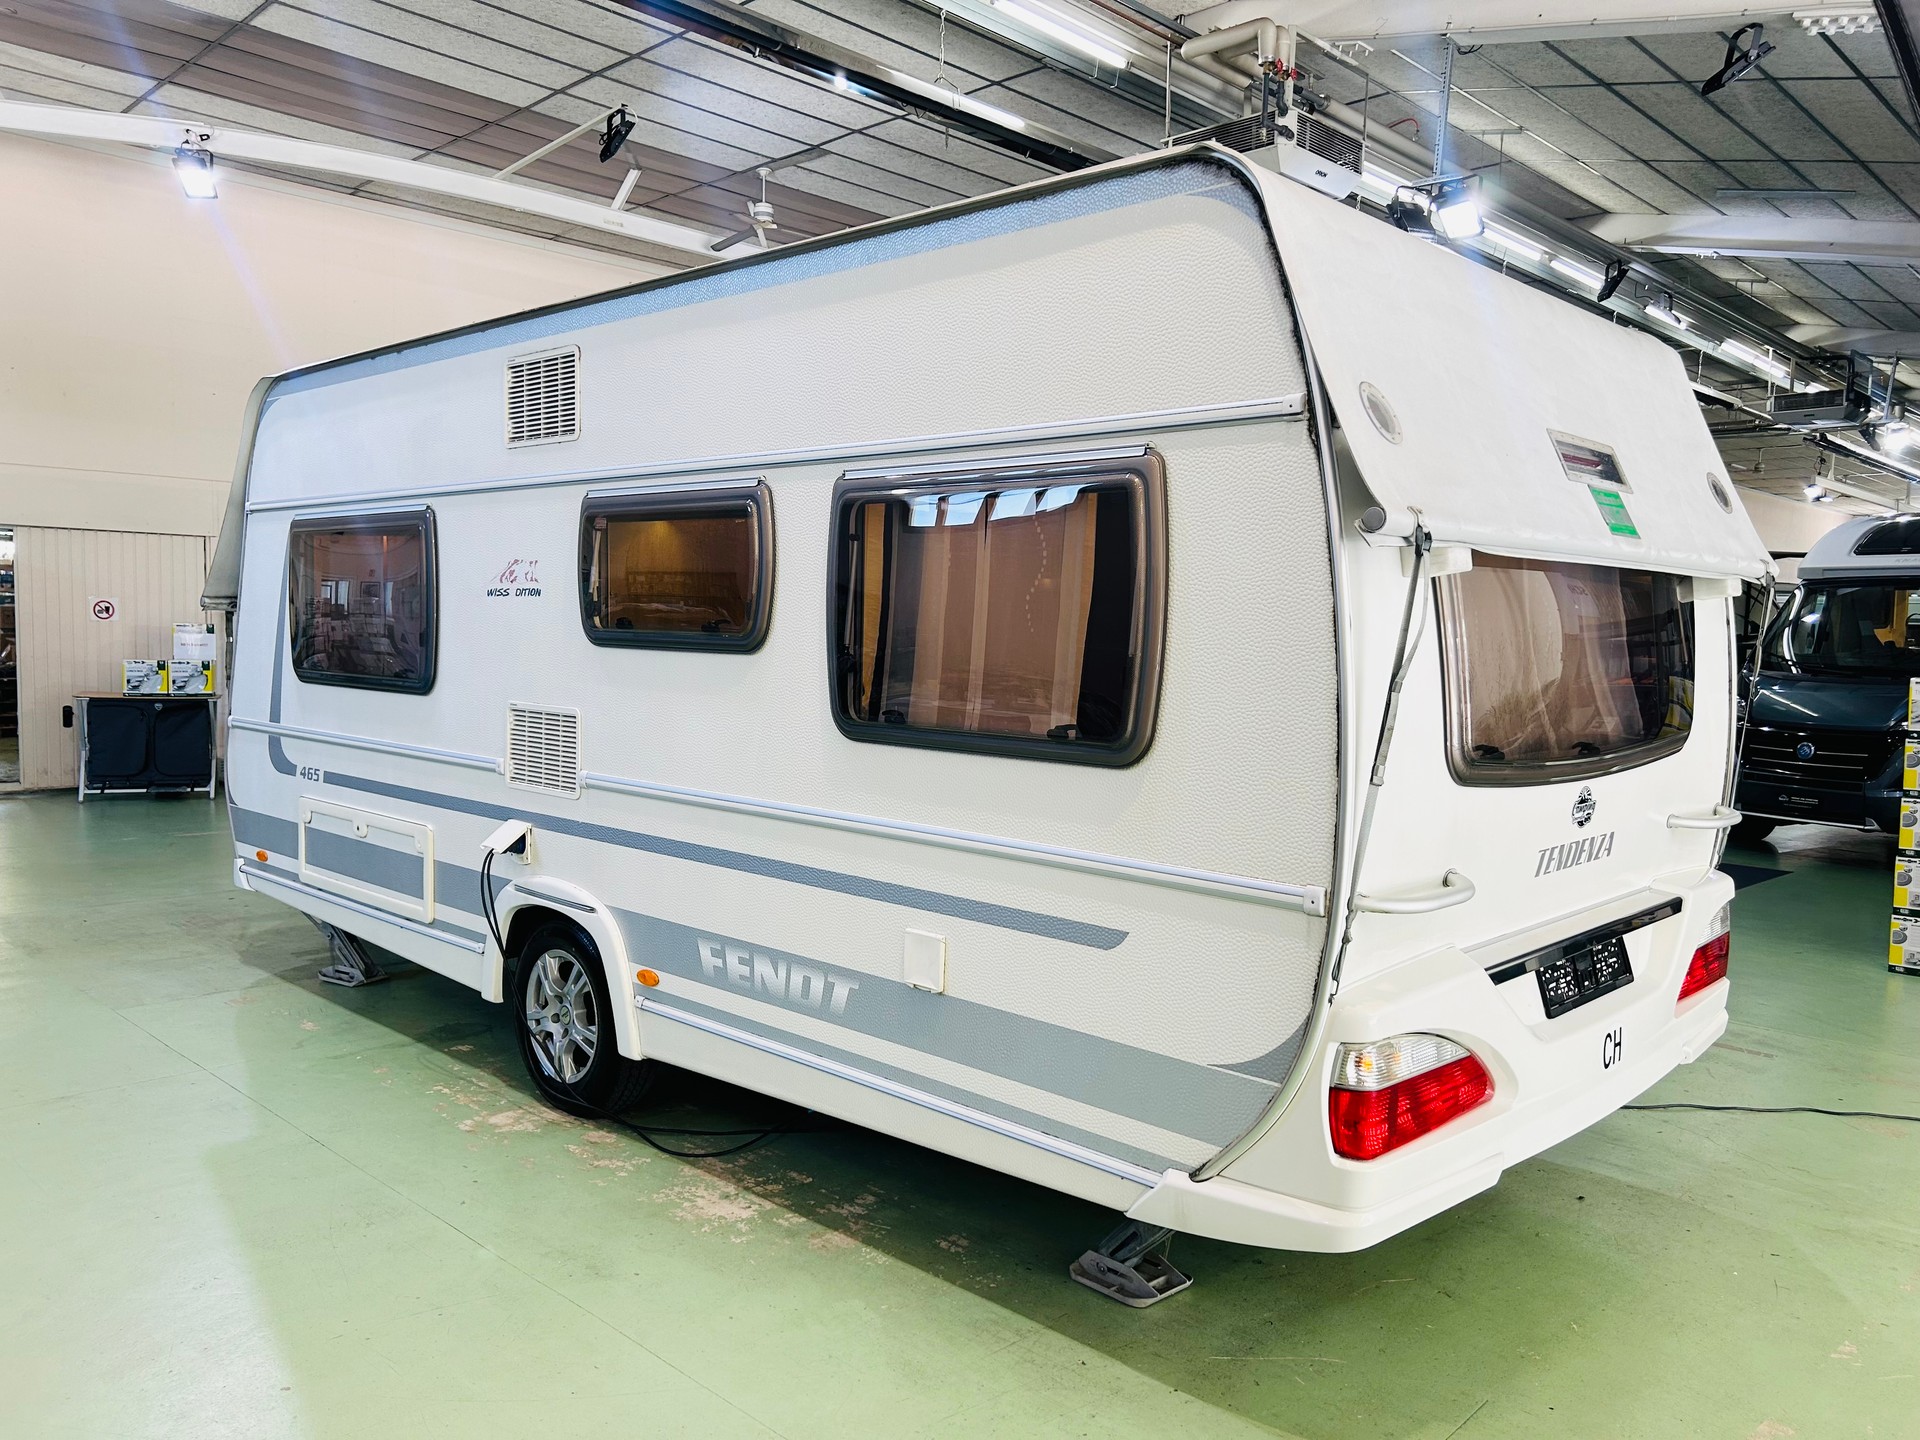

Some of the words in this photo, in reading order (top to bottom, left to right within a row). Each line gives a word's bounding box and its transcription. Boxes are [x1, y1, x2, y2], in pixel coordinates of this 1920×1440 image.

[486, 587, 510, 597] WISS
[515, 587, 541, 597] DITION
[300, 766, 321, 782] 465
[1534, 831, 1615, 878] TENDENZA
[697, 936, 861, 1015] FENDT
[1603, 1026, 1622, 1070] CH
